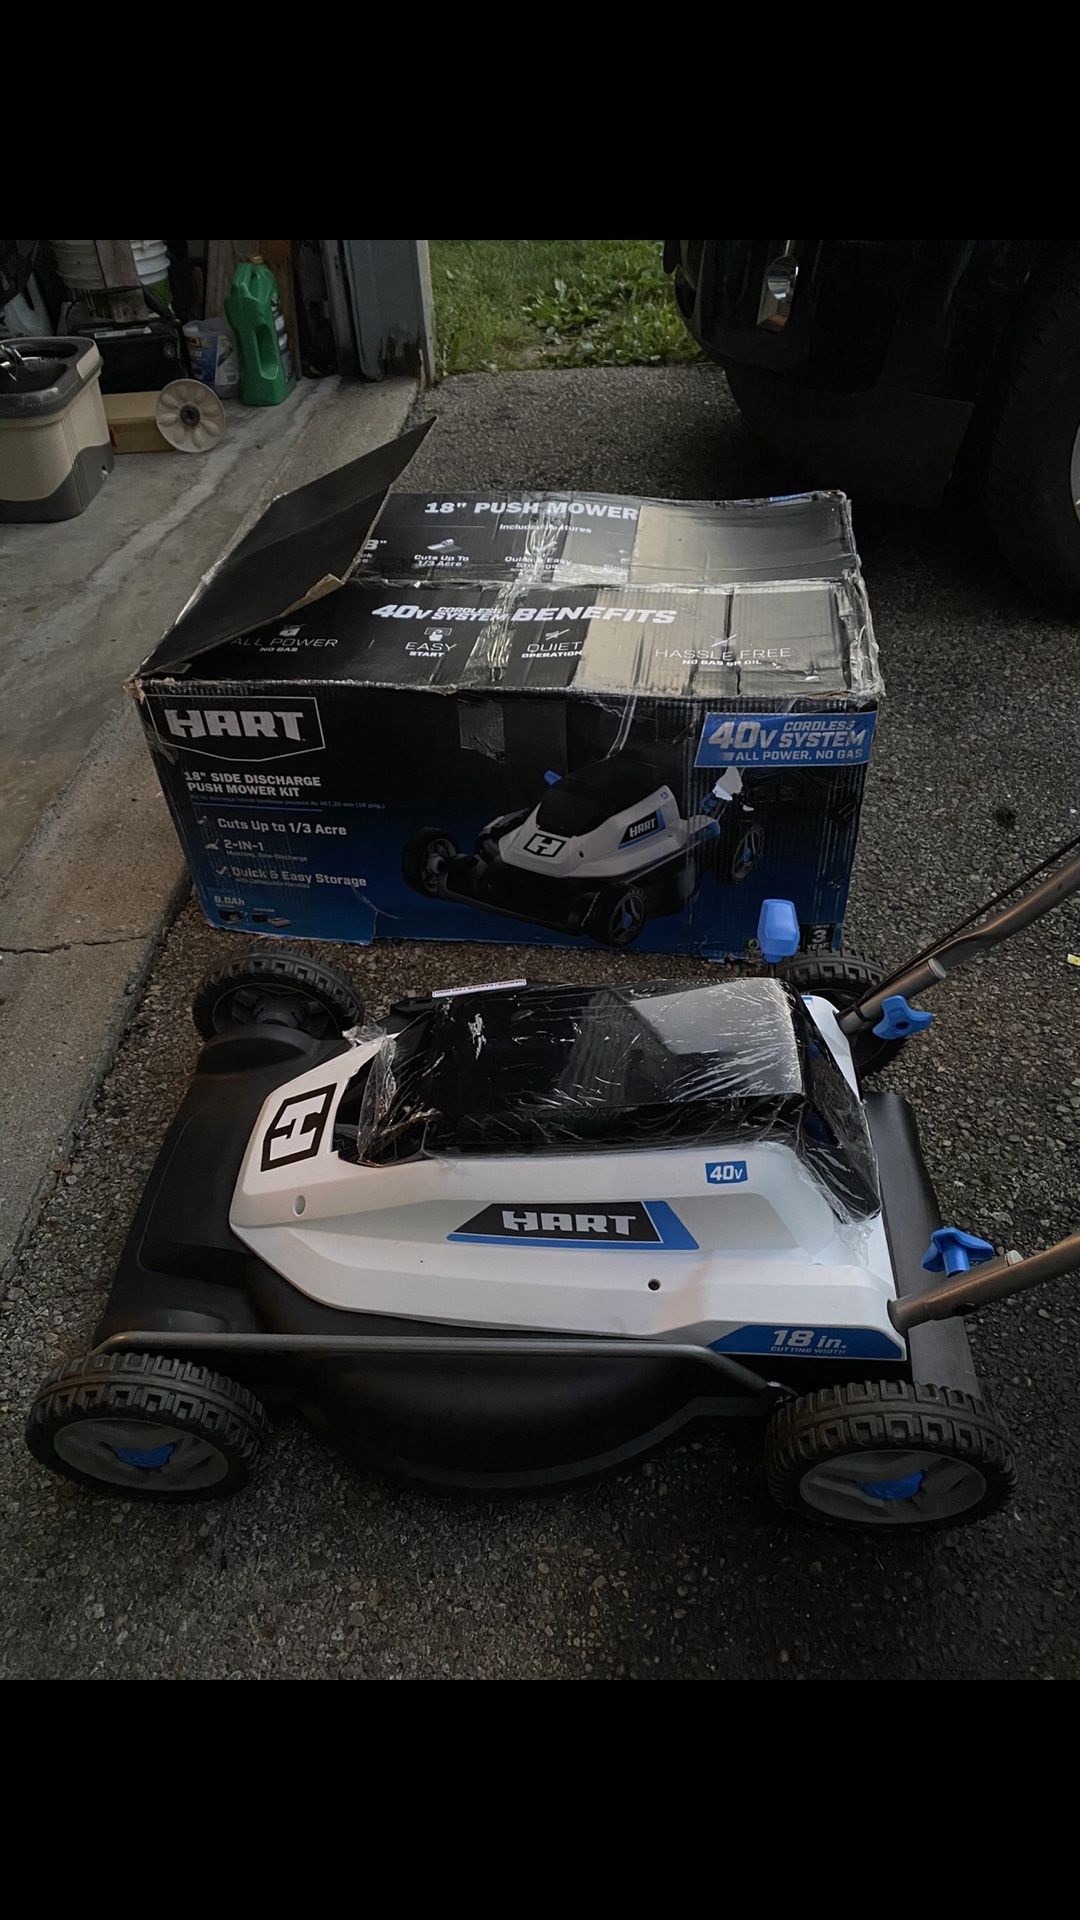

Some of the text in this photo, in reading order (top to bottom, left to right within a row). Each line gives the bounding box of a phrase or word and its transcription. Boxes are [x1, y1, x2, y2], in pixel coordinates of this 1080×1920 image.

[424, 502, 639, 520] 18" PUSH MOWER
[547, 523, 592, 533] eatures
[516, 562, 558, 570] Stoge
[511, 606, 677, 624] BENEFITS
[229, 637, 339, 648] ALL POWER
[405, 641, 457, 653] EASY
[527, 641, 583, 653] QUIET
[409, 650, 445, 658] START
[521, 650, 583, 659] OPERATION
[655, 647, 792, 661] HASSLE FREE
[163, 708, 305, 742] HART
[783, 720, 855, 732] CORDLESS
[778, 730, 866, 748] SYSTEM
[735, 748, 863, 762] ALL POWER, NO GAS
[184, 771, 322, 787] 18" SIDE DISCHARGE
[187, 782, 301, 798] PUSH MOWER KIT
[217, 817, 348, 836] Cuts Up to 1/3 Acre
[629, 818, 656, 838] HART
[223, 838, 265, 851] 2-IN-1
[231, 866, 268, 878] Quick
[269, 870, 279, 880] &
[281, 871, 312, 884] Easy
[316, 873, 368, 887] Storage
[811, 929, 828, 943] 3
[501, 1209, 637, 1236] HART
[773, 1329, 847, 1349] 18 in.
[770, 1346, 847, 1356] CUTTING WIDTH
